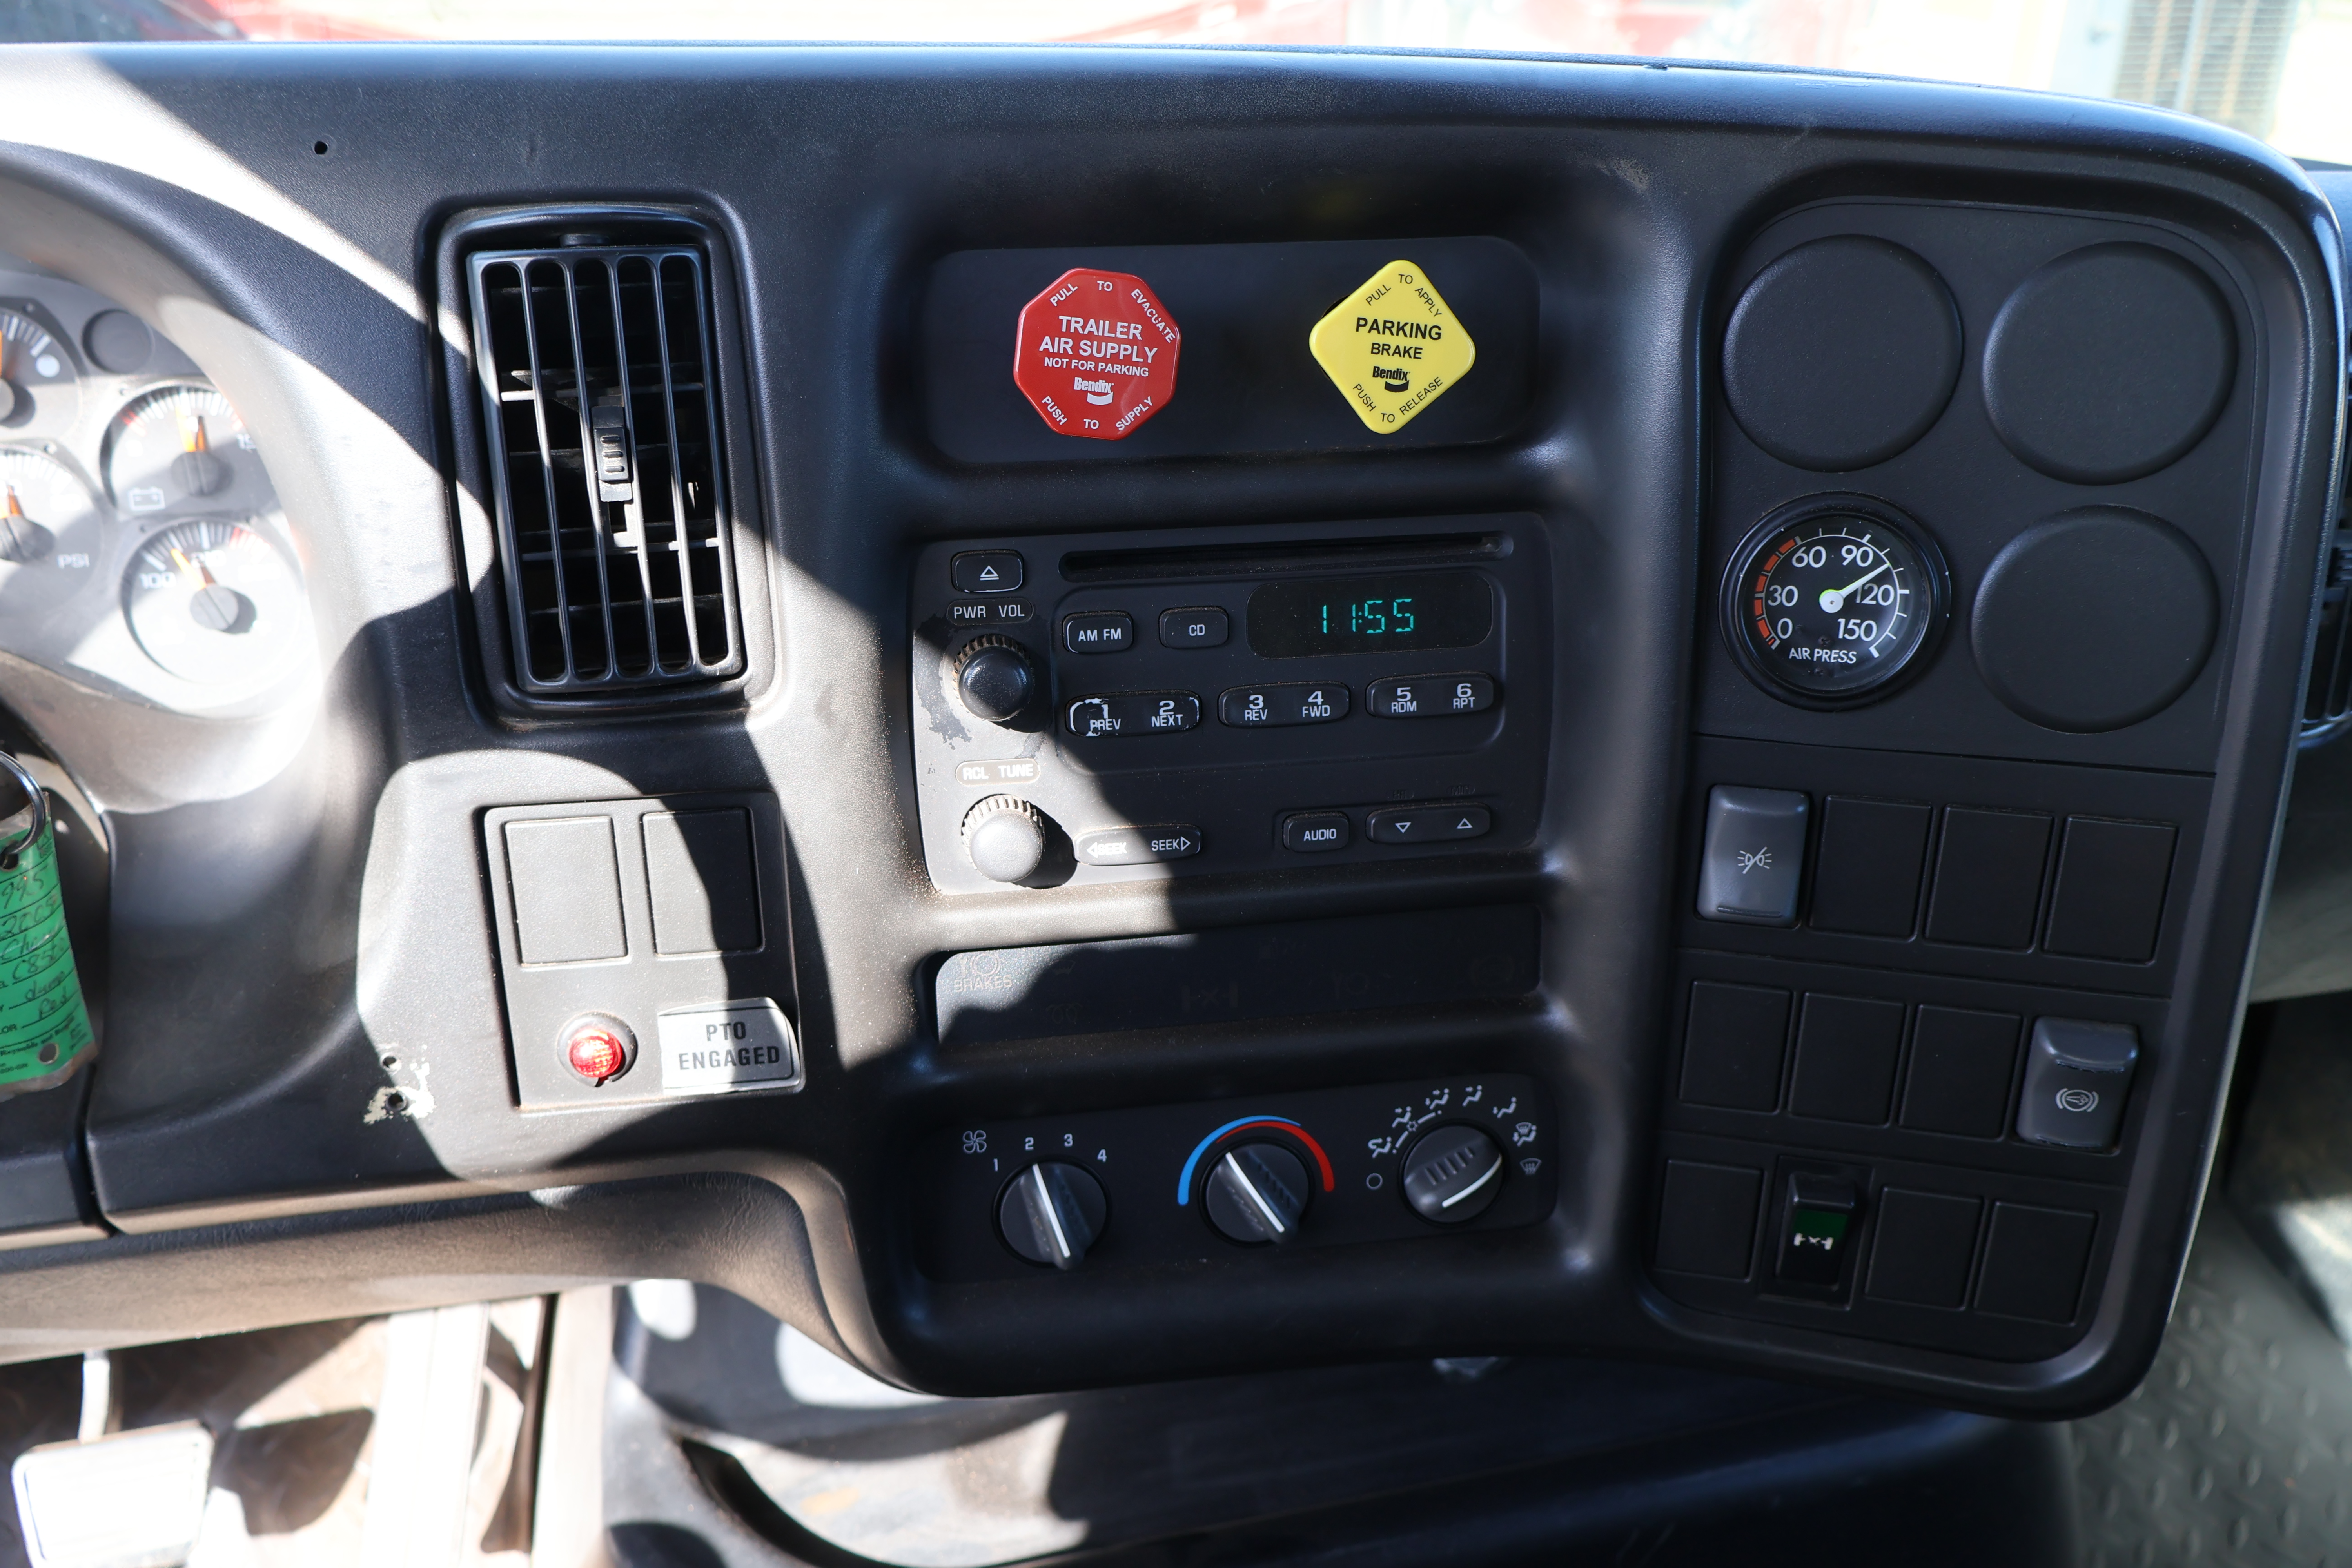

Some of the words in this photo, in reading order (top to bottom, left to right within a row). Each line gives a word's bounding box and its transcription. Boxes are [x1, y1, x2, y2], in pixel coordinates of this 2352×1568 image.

[1365, 284, 1391, 306] PULL
[1398, 274, 1414, 284] TO
[1414, 287, 1443, 317] APPLY
[1050, 283, 1078, 307] PULL
[1097, 280, 1113, 292] TO
[1131, 289, 1176, 343] EVACUATE
[1058, 315, 1142, 341] TRAILER
[1355, 317, 1442, 341] PARKING
[1039, 336, 1073, 354] AIR
[1078, 340, 1158, 363] SUPPLY
[1370, 342, 1423, 360] BRAKE
[1044, 357, 1069, 369] NOT
[1071, 359, 1095, 371] FOR
[1098, 362, 1149, 377] PARKING
[1372, 365, 1410, 381] Bendix
[1074, 377, 1113, 393] Bendix
[1352, 383, 1376, 412] PUSH
[1380, 413, 1396, 423] TO
[1399, 376, 1443, 416] RELEASE
[1041, 396, 1068, 425] PUSH
[1083, 418, 1099, 430] TO
[1116, 396, 1154, 431] SUPPLY
[57, 553, 90, 568] PSI
[1791, 546, 1827, 568] 60
[1841, 544, 1874, 567] 90
[140, 572, 176, 588] 100
[1767, 585, 1799, 607] 30
[1855, 583, 1895, 606] 120
[953, 606, 986, 619] PWR
[998, 604, 1025, 617] VOL
[1322, 598, 1414, 634] 11:55
[1078, 630, 1098, 642] AM
[1103, 628, 1122, 640] FM
[1189, 624, 1206, 637] CD
[1776, 617, 1793, 639] 0
[1837, 618, 1878, 642] 150
[1789, 647, 1811, 660] AIR
[1813, 648, 1857, 664] PRESS
[1249, 694, 1264, 709] 3
[1308, 691, 1323, 705] 4
[1397, 687, 1412, 701] 5
[1456, 683, 1472, 697] 6
[1159, 700, 1175, 715] 2
[1244, 708, 1268, 721] REV
[1302, 705, 1330, 718] FWD
[1391, 701, 1417, 713] RDM
[1453, 697, 1475, 709] RPT
[1090, 718, 1122, 731] PREV
[1151, 714, 1183, 728] NEXT
[962, 767, 989, 781] RCL
[998, 764, 1034, 778] TUNE
[1303, 828, 1337, 841] AUDIO
[1098, 842, 1127, 856] SEEK
[1151, 838, 1180, 851] SEEK
[954, 974, 1012, 993] BRAKES
[706, 1021, 747, 1042] PTO
[679, 1045, 780, 1071] ENGAGED
[993, 1158, 999, 1172] 1
[1025, 1137, 1034, 1151] 2
[1063, 1133, 1073, 1147] 3
[1098, 1149, 1107, 1162] 4
